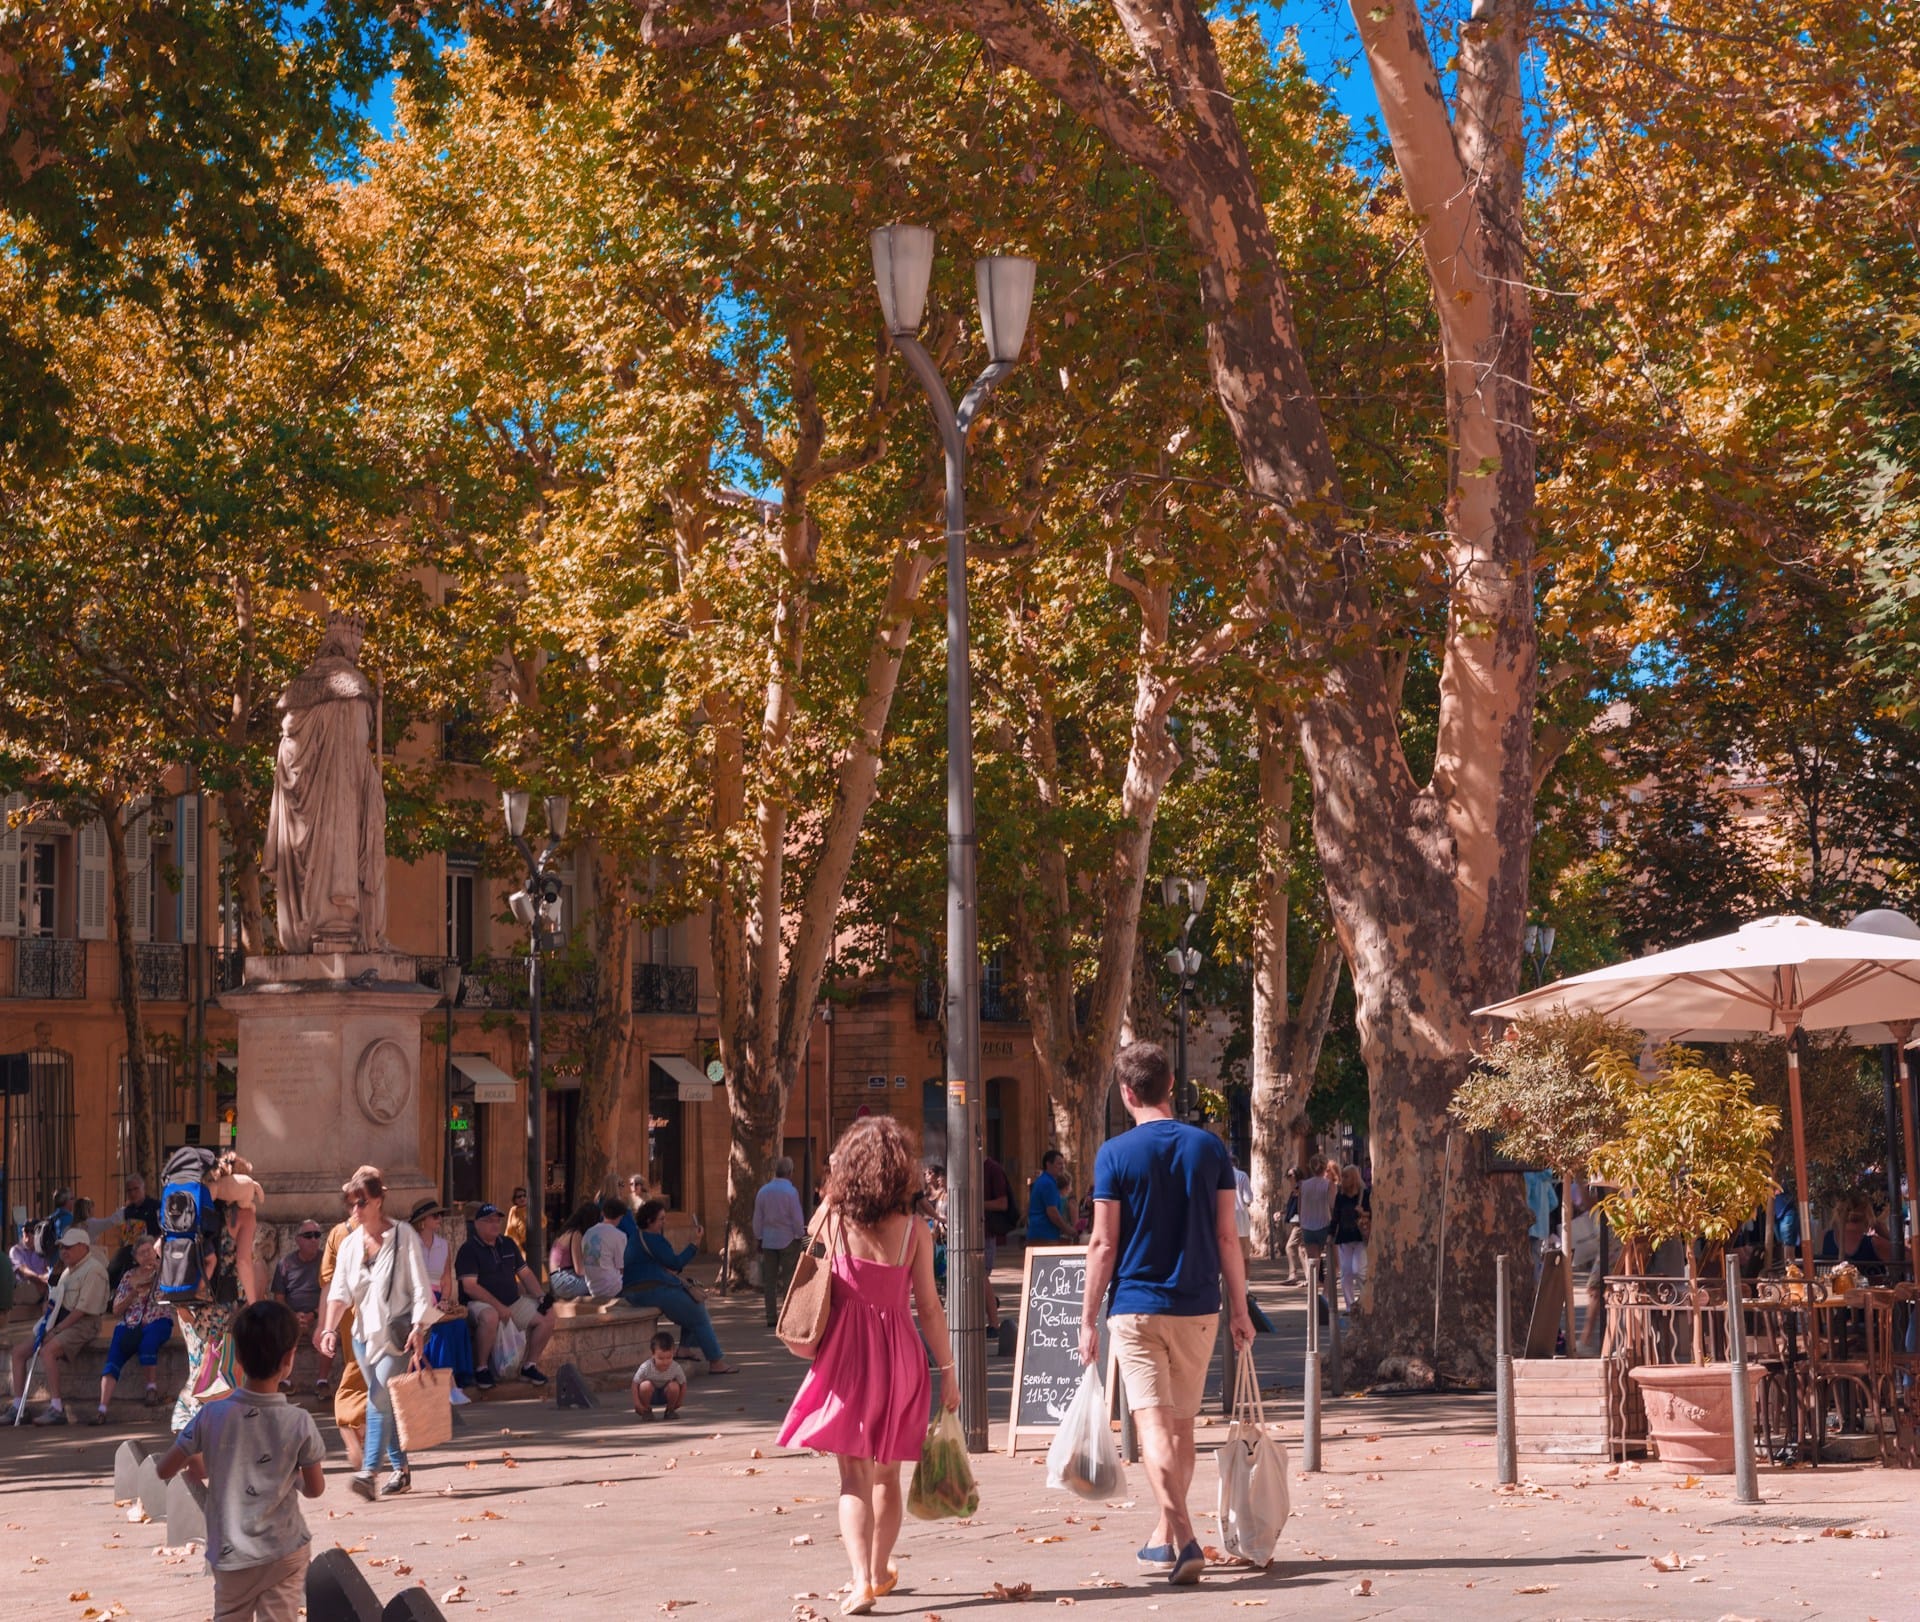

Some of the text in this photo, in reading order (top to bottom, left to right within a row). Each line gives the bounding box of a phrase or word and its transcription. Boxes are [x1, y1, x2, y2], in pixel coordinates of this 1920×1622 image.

[1030, 1269, 1048, 1298] Le
[1050, 1267, 1071, 1296] Petit
[1037, 1302, 1083, 1327] Restaur
[1031, 1329, 1058, 1347] Bar
[1060, 1331, 1070, 1348] à
[1056, 1376, 1071, 1385] non
[1025, 1387, 1058, 1404] 11h30
